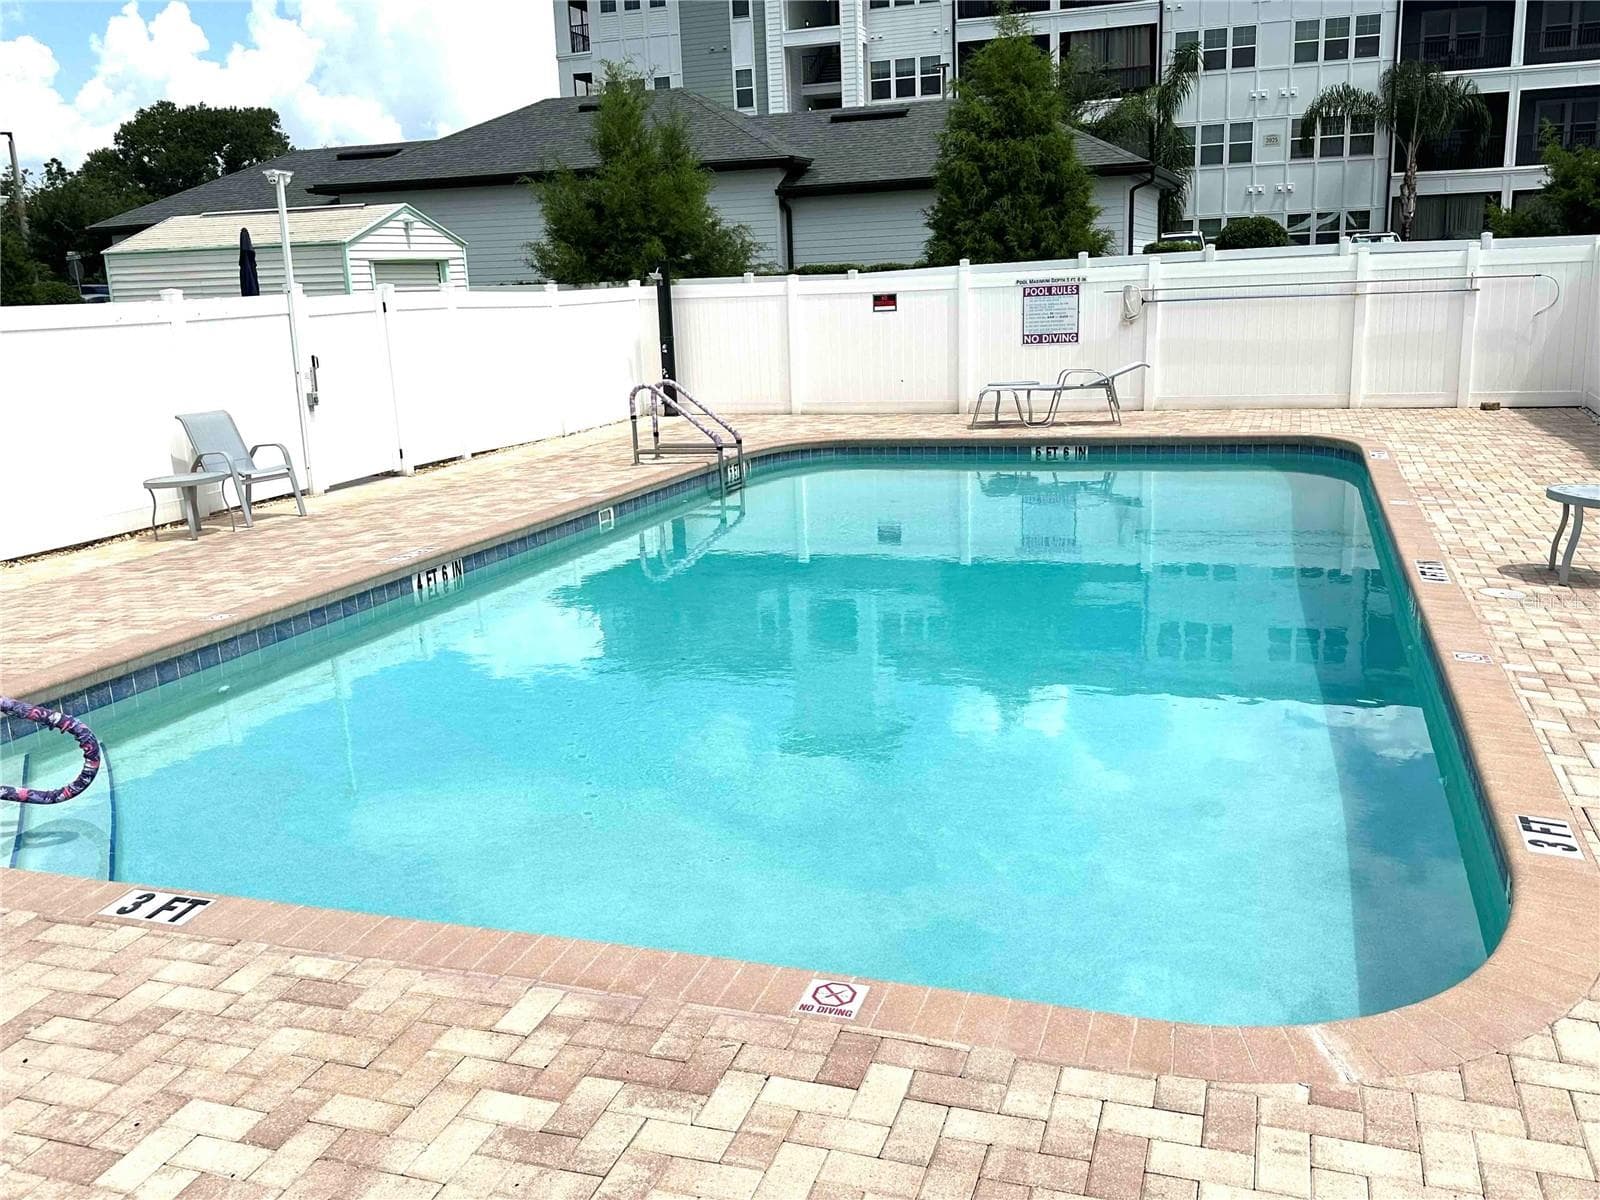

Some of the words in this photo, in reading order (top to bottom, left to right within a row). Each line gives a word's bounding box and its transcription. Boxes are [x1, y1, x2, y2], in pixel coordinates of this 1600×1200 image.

[1025, 287, 1049, 296] POOL
[1051, 285, 1077, 295] RULES
[1024, 335, 1039, 343] NO
[1042, 333, 1077, 343] DIVING
[1046, 446, 1058, 456] FT
[1063, 446, 1070, 456] 6
[1074, 446, 1086, 456] IN
[417, 573, 423, 590] 4
[425, 567, 438, 588] FT
[441, 564, 449, 583] 6
[451, 559, 463, 579] IN
[1518, 815, 1572, 838] FT
[1527, 838, 1578, 852] 3
[116, 893, 156, 915] 3
[144, 896, 212, 923] FT
[798, 1003, 815, 1012] NO
[816, 1006, 853, 1018] DIVING
